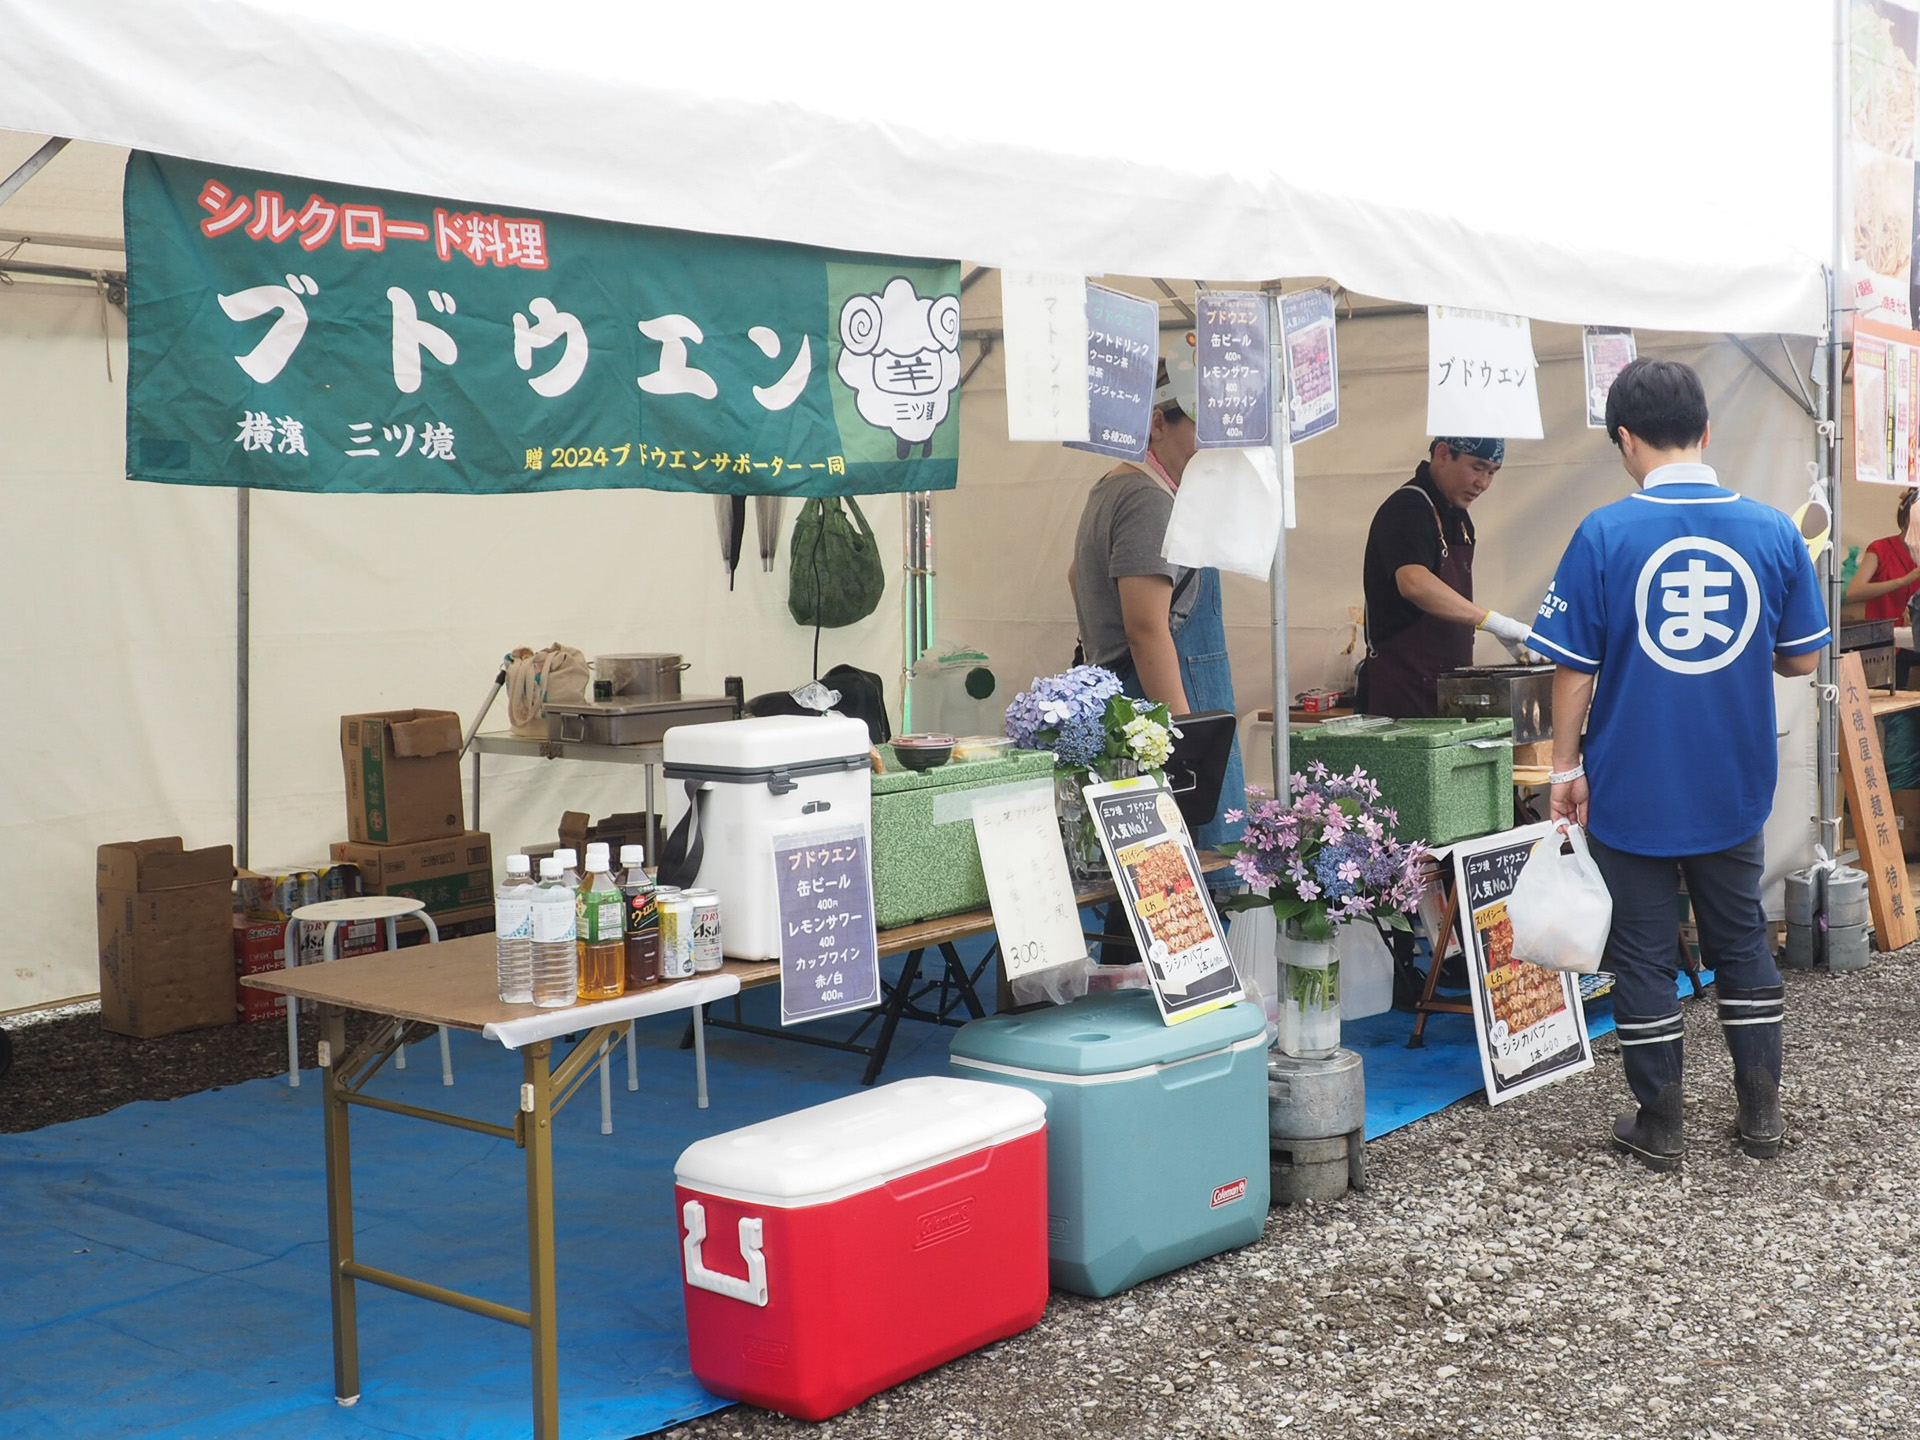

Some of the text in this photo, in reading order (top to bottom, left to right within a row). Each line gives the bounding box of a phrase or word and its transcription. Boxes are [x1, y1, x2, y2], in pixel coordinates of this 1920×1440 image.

[199, 180, 548, 268] シルクロード料理
[1207, 311, 1258, 326] ブドウエン
[217, 273, 812, 410] ブドウエン
[1211, 333, 1252, 348] 缶ビール
[1089, 349, 1130, 369] ウーロン茶
[1225, 352, 1241, 361] 400円
[886, 357, 935, 390] 羊
[1203, 366, 1260, 379] レモンサワー
[1437, 356, 1527, 389] ブドウエン
[1225, 383, 1238, 393] 400
[1207, 396, 1257, 408] カップワイン
[1221, 414, 1244, 426] 赤/白
[235, 411, 457, 461] 横濱 三ツ境
[1226, 427, 1243, 438] 400円
[524, 447, 543, 471] 贈
[1659, 559, 1735, 650] ま
[1127, 801, 1156, 814] ブドウエン
[1111, 819, 1149, 840] 人気No.1
[788, 846, 857, 871] ブドウエン
[1119, 849, 1144, 863] スパイシー
[1470, 851, 1528, 875] 三ツ境 ブドウエン
[797, 874, 851, 897] 缶ビール
[1473, 873, 1514, 901] 人気No.1
[817, 898, 838, 910] 400円
[1144, 902, 1157, 912] しお
[788, 912, 863, 937] レモンサワー
[1475, 910, 1502, 927] スパイシー
[819, 936, 835, 948] 400
[795, 947, 860, 971] カップワイン
[1010, 940, 1039, 969] 300
[1165, 945, 1210, 973] シシカバブー
[815, 972, 843, 989] 赤/白
[1490, 971, 1503, 984] しお
[821, 990, 844, 1002] 400円
[1503, 1022, 1556, 1056] シシカバブー
[1213, 1186, 1239, 1203] Coleman
